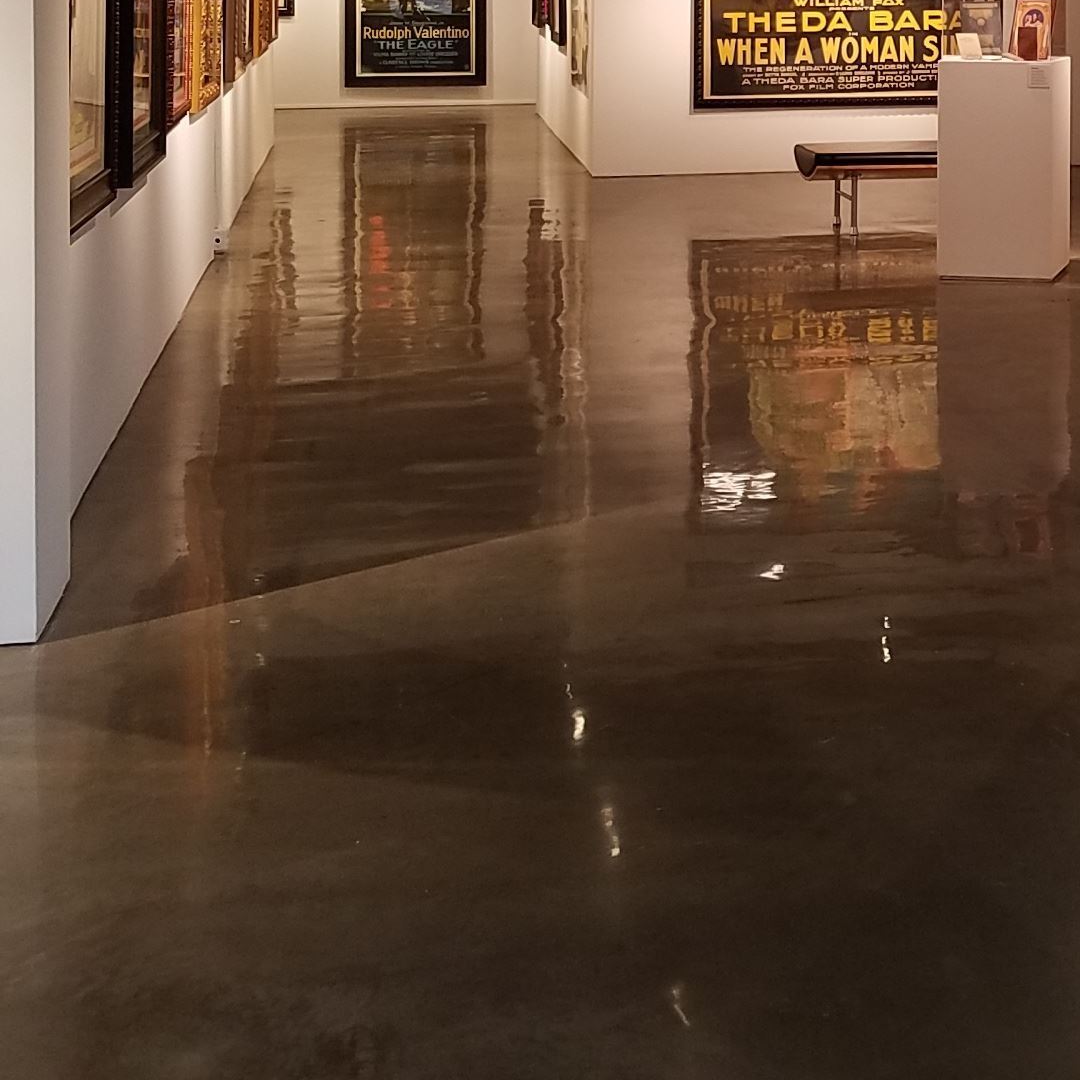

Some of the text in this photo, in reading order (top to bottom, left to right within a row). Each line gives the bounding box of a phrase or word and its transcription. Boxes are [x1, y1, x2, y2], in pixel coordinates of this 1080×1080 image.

[722, 10, 853, 34] THEDA
[363, 25, 470, 40] Rudolph Valentino
[716, 37, 786, 66] WHEN
[793, 36, 815, 65] A
[819, 34, 915, 65] WOMAN
[765, 65, 843, 73] REGENERATION
[845, 64, 858, 72] OF
[869, 63, 910, 71] MODERN
[741, 78, 752, 86] A
[753, 77, 796, 85] THEDA
[799, 76, 835, 84] BARA
[837, 75, 874, 83] SUPER
[808, 83, 834, 91] FILM
[837, 81, 915, 90] CORPORATION
